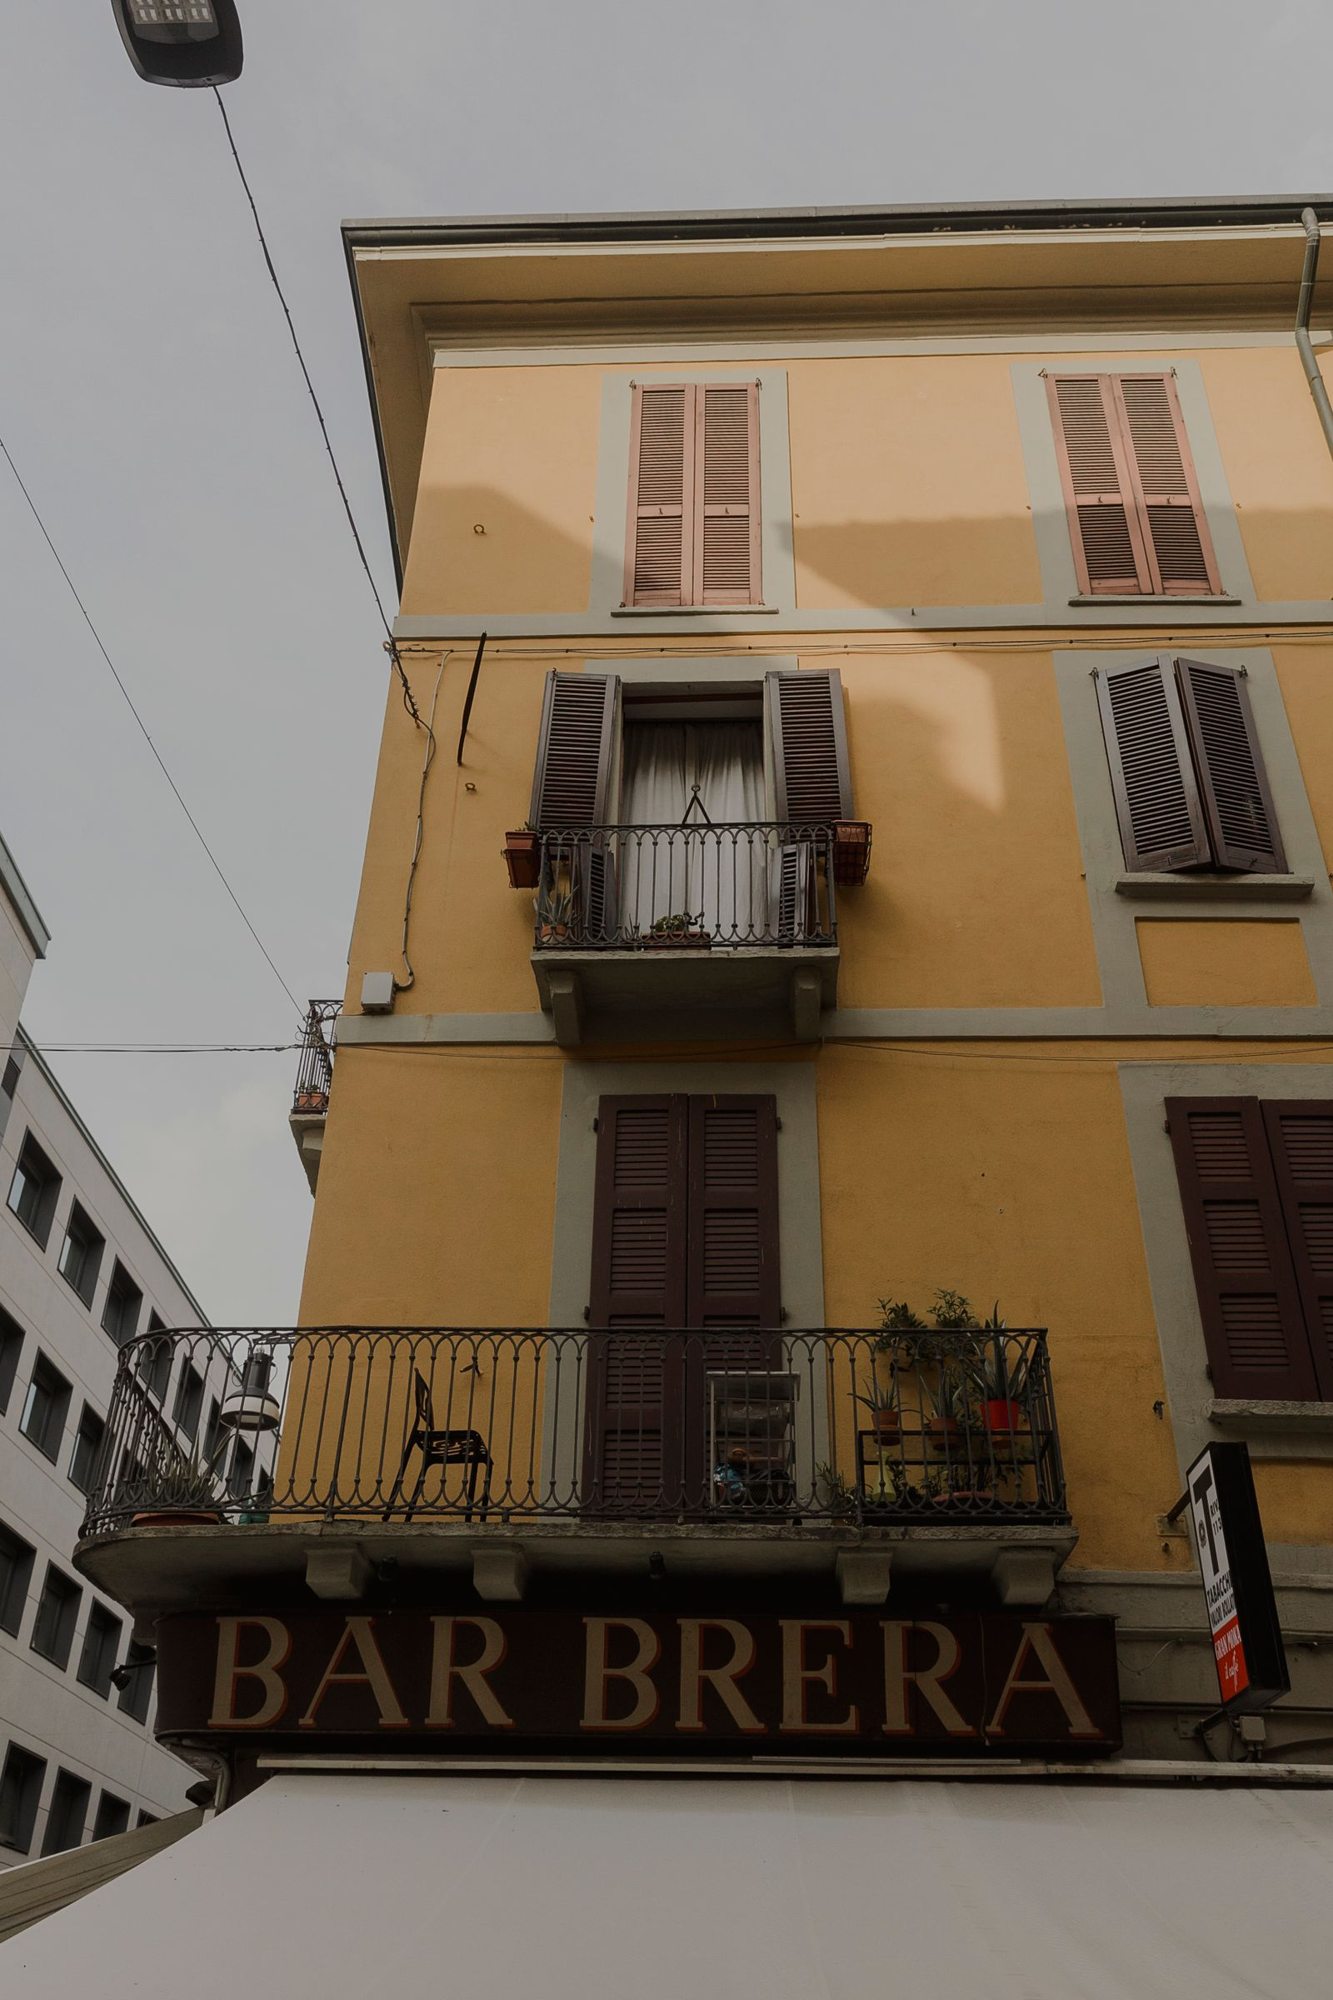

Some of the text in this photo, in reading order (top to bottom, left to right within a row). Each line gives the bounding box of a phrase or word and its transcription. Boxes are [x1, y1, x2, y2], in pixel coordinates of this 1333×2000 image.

[1193, 1464, 1219, 1576] T
[207, 1616, 1102, 1737] BAR BRERA
[1214, 1634, 1228, 1660] GRAN
